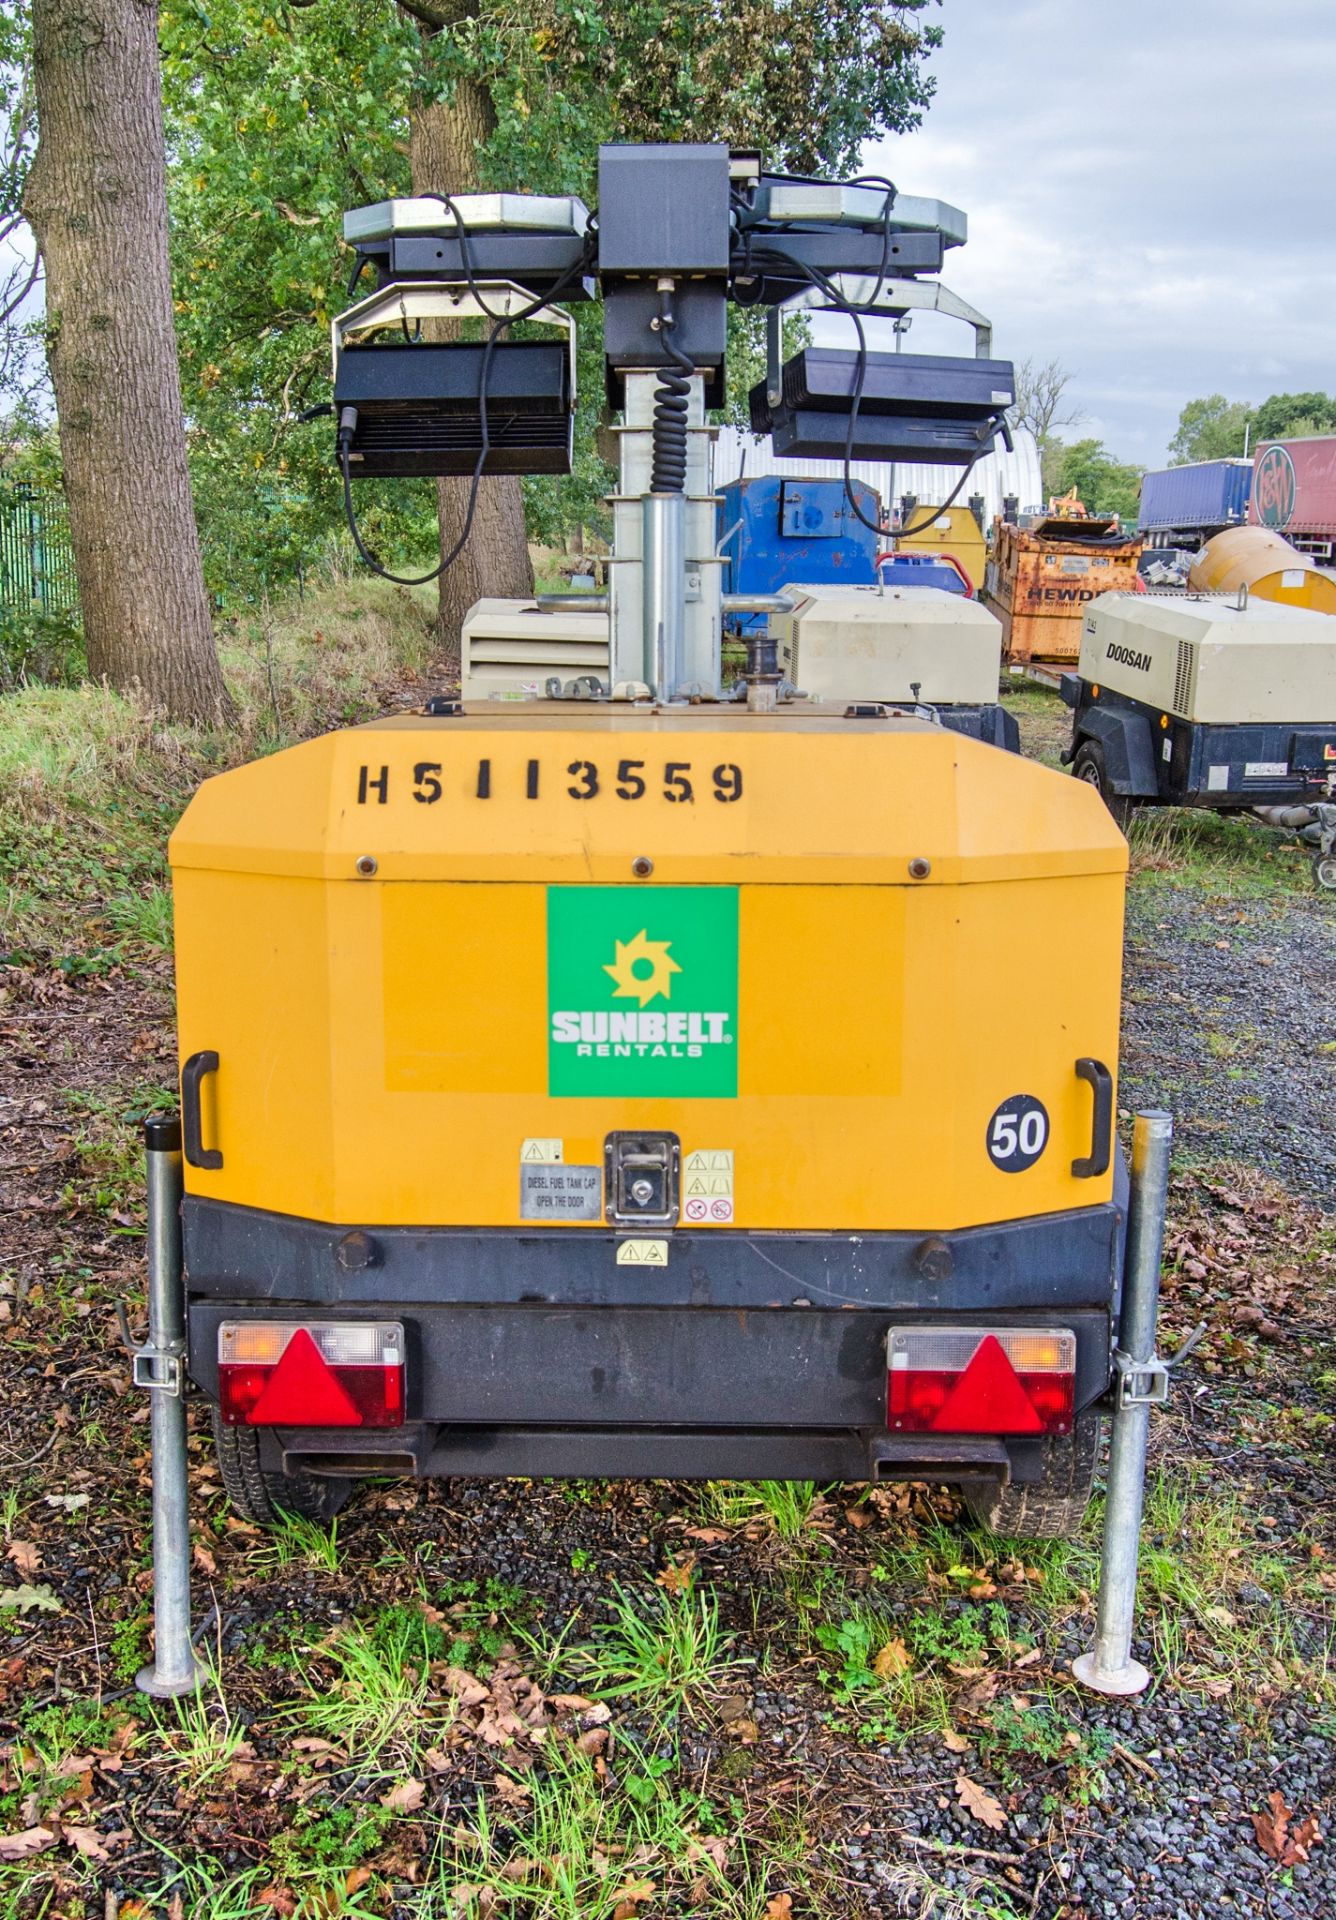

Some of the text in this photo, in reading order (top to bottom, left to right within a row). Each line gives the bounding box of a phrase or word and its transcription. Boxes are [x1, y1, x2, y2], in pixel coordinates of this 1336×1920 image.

[1106, 642, 1152, 672] DOOSAN
[552, 1011, 730, 1044] SUNBELT
[576, 1044, 703, 1057] RENTALS
[990, 1110, 1046, 1159] 50
[527, 1176, 596, 1190] DIESEL FUEL TANK CAP
[536, 1195, 585, 1208] OPEN THE DOOR
